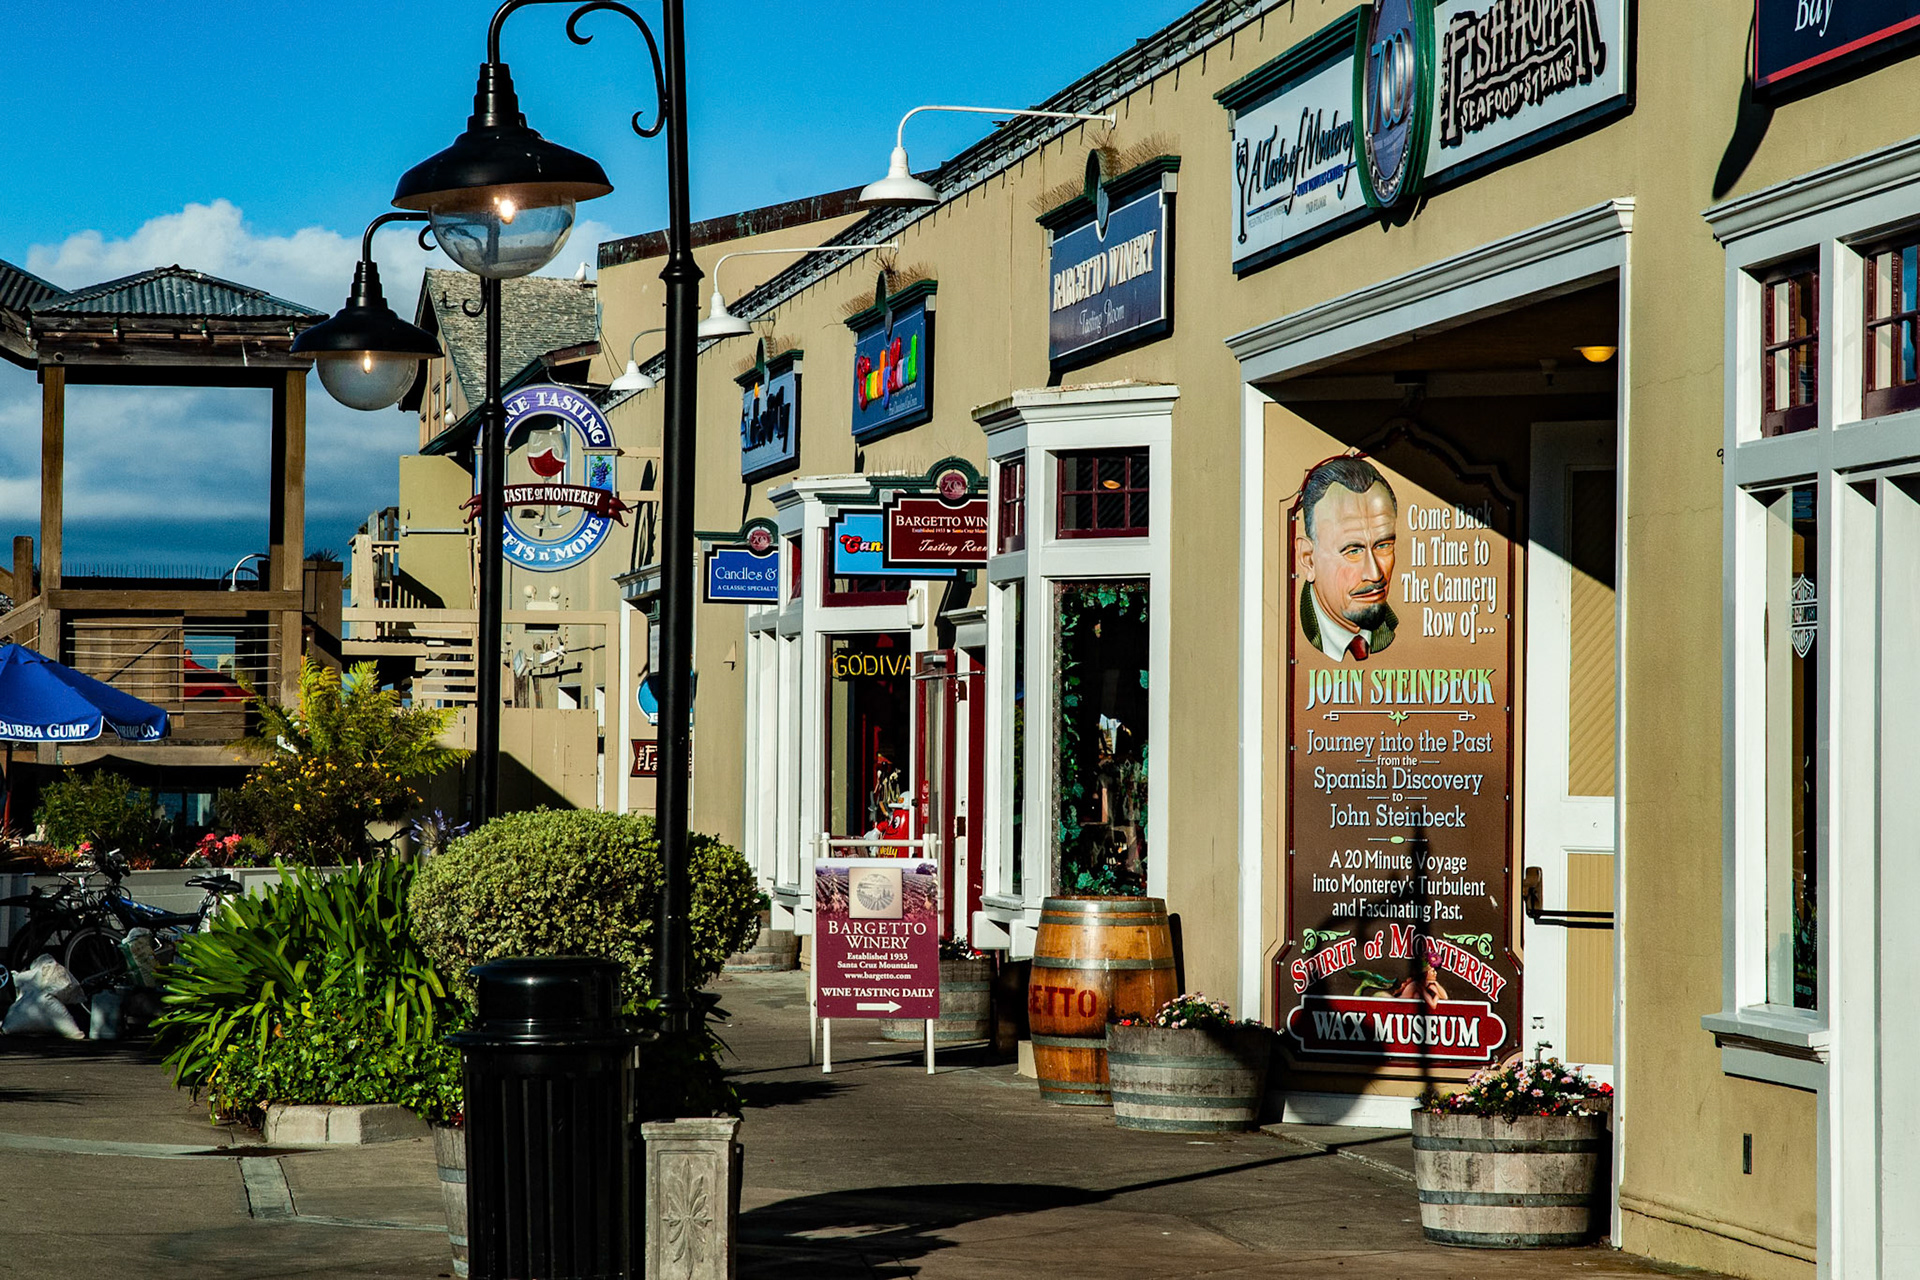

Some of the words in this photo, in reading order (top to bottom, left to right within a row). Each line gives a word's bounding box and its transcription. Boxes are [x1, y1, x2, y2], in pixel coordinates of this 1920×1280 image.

[1794, 0, 1834, 37] Bay
[1370, 28, 1411, 133] 700
[1446, 0, 1508, 140] FISH
[1248, 140, 1262, 206] A
[1261, 125, 1290, 190] Taste
[1285, 107, 1308, 216] of
[1301, 108, 1354, 201] Monterey
[1052, 252, 1107, 312] BARGETTO
[1108, 229, 1157, 287] WINERY
[1080, 308, 1103, 334] Tasting
[1104, 299, 1125, 327] Room
[536, 391, 606, 445] TASTING
[503, 487, 534, 503] TASTE
[544, 487, 602, 506] MONTEREY
[896, 515, 961, 527] BARGETTO
[1407, 503, 1451, 531] Come
[1454, 502, 1493, 531] Back
[553, 517, 604, 563] MORE
[839, 534, 883, 554] Can
[918, 539, 957, 556] Tasting
[1410, 536, 1428, 567] In
[1430, 535, 1468, 567] Time
[1473, 535, 1490, 567] to
[715, 566, 763, 580] Candles
[765, 568, 778, 581] &
[1401, 573, 1431, 603] The
[1433, 572, 1498, 614] Cannery
[1422, 606, 1457, 638] Row
[833, 654, 911, 676] GODIVA
[1306, 669, 1365, 711] JOHN
[1370, 668, 1497, 705] STEINBECK
[0, 721, 43, 738] BUBBA
[46, 723, 90, 738] GUMP
[1306, 729, 1376, 757] Journey
[1380, 731, 1414, 753] into
[1417, 730, 1448, 753] the
[1452, 730, 1493, 753] Past
[1376, 754, 1400, 767] from
[1402, 754, 1418, 767] the
[1314, 767, 1388, 794] Spanish
[1391, 767, 1483, 795] Discovery
[1392, 792, 1403, 803] to
[1329, 804, 1371, 829] John
[1376, 803, 1466, 829] Steinbeck
[1329, 850, 1343, 869] A
[1344, 849, 1362, 869] 20
[1364, 849, 1413, 870] Minute
[1415, 850, 1468, 875] Voyage
[1312, 874, 1339, 893] into
[1341, 874, 1415, 897] Monterey's
[1419, 875, 1486, 897] Turbulent
[1332, 899, 1356, 917] and
[1359, 898, 1431, 922] Fascinating
[1434, 901, 1464, 920] Past.
[828, 920, 927, 935] BARGETTO
[846, 935, 910, 950] WINERY
[837, 961, 858, 969] Santa
[859, 961, 877, 969] Cruz
[879, 962, 918, 970] Mountains
[847, 952, 888, 961] Established
[890, 953, 908, 961] 1933
[1291, 937, 1357, 993] SPIRIT
[1364, 930, 1385, 960] of
[1389, 924, 1507, 1003] MONTEREY
[844, 972, 911, 981] www.bargetto.com
[820, 987, 852, 997] WINE
[853, 988, 900, 998] TASTING
[902, 988, 935, 998] DAILY
[1029, 984, 1097, 1018] ETTO
[1311, 1011, 1367, 1041] WAX
[1372, 1011, 1480, 1048] MUSEUM
